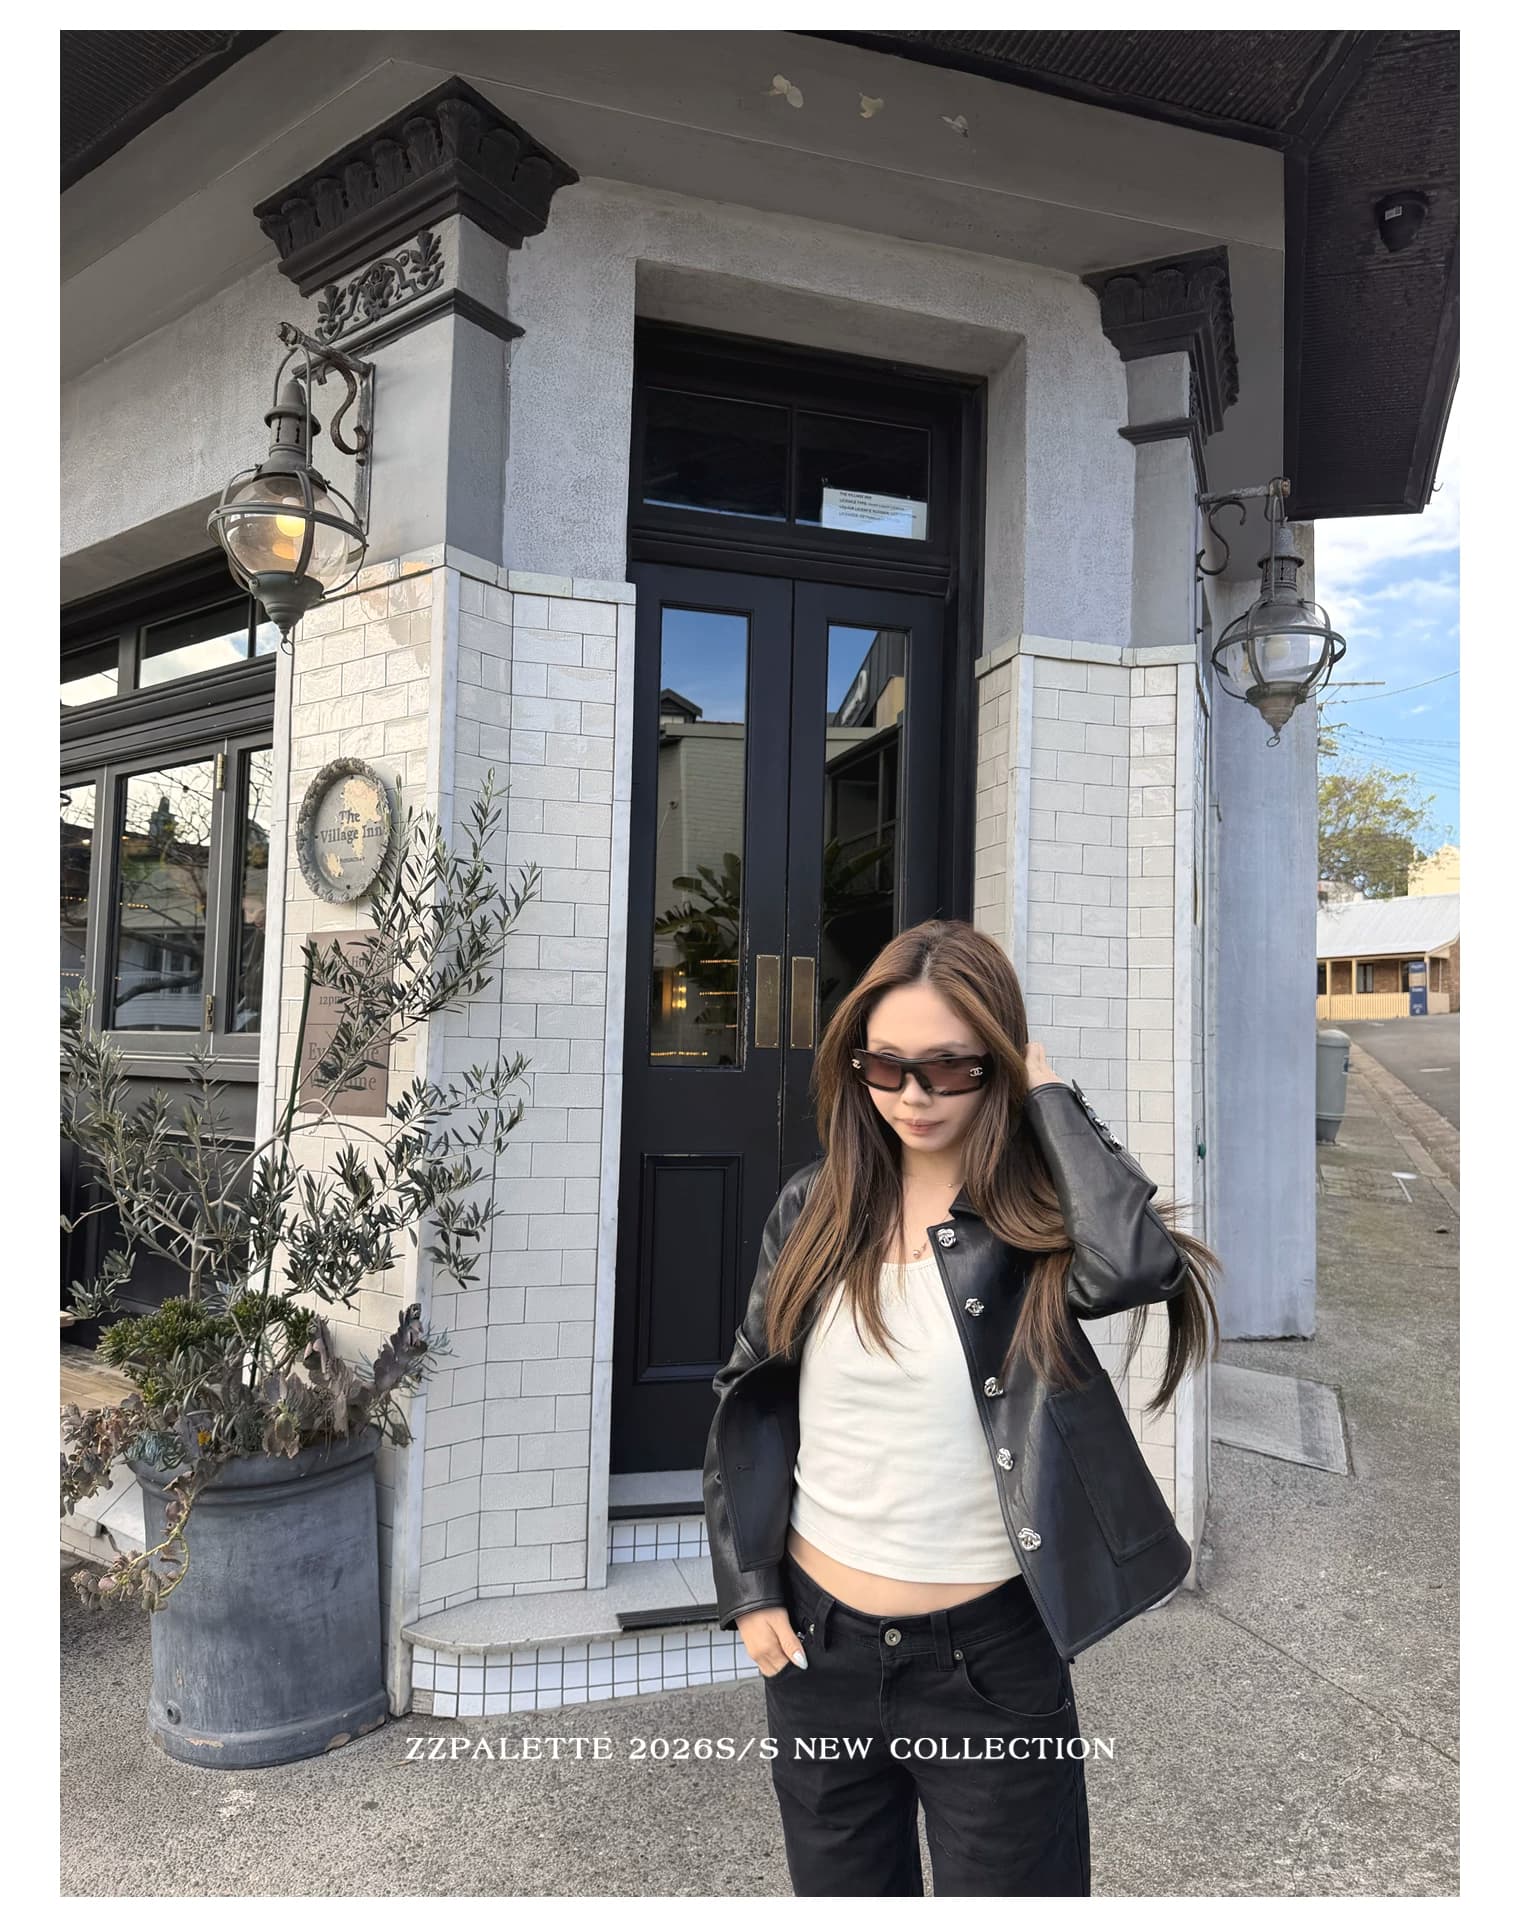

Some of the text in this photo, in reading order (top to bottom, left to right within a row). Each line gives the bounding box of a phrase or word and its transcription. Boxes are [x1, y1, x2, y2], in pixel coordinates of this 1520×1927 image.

[340, 808, 360, 823] The
[320, 824, 382, 844] Village Inn
